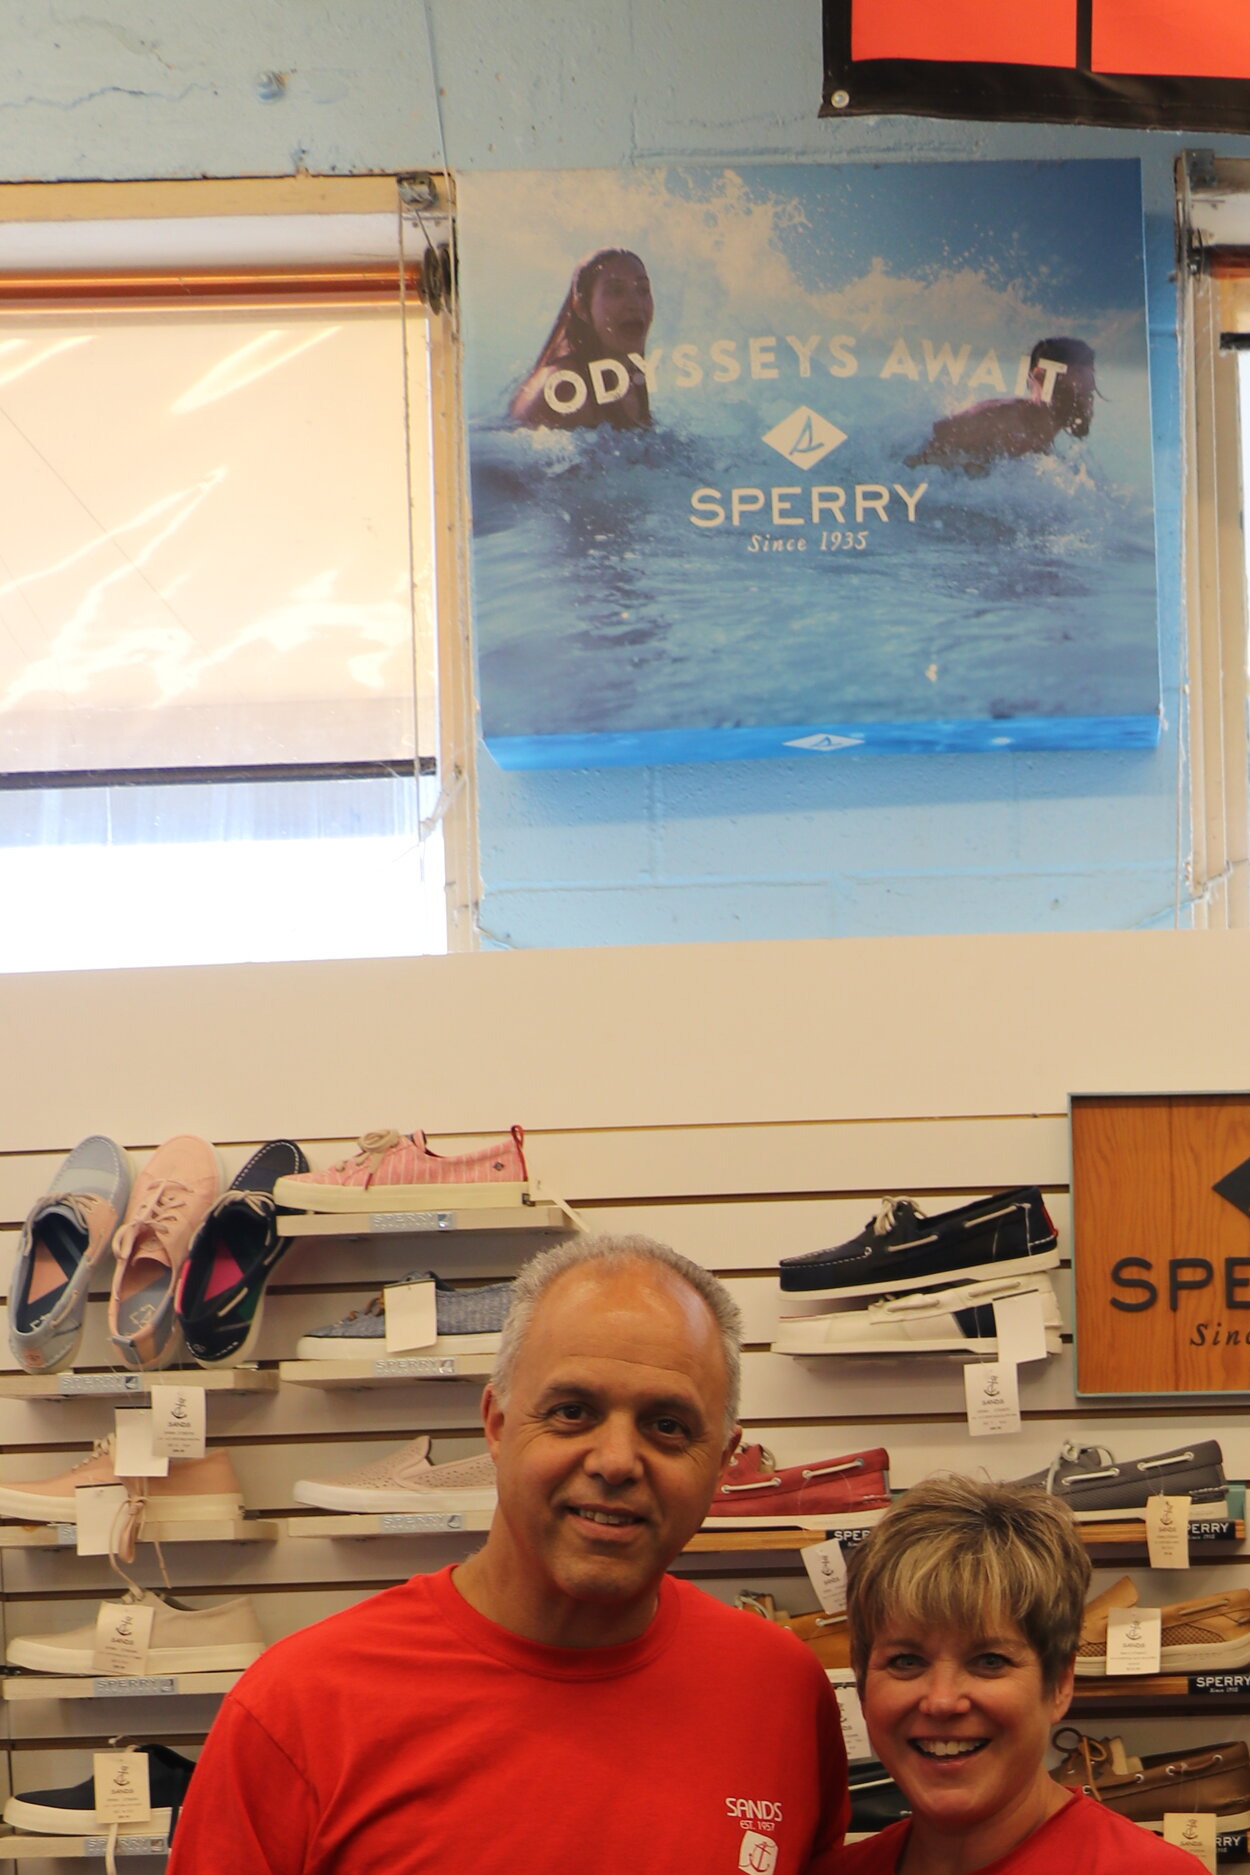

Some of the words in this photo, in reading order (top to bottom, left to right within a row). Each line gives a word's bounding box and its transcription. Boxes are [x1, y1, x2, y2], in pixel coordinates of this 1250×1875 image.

[543, 334, 859, 414] ODYSSEYS
[878, 338, 1069, 404] AWAIT
[689, 482, 930, 527] SPERRY
[747, 532, 807, 553] Since
[820, 530, 869, 551] 1935
[725, 1797, 783, 1822] SANDS
